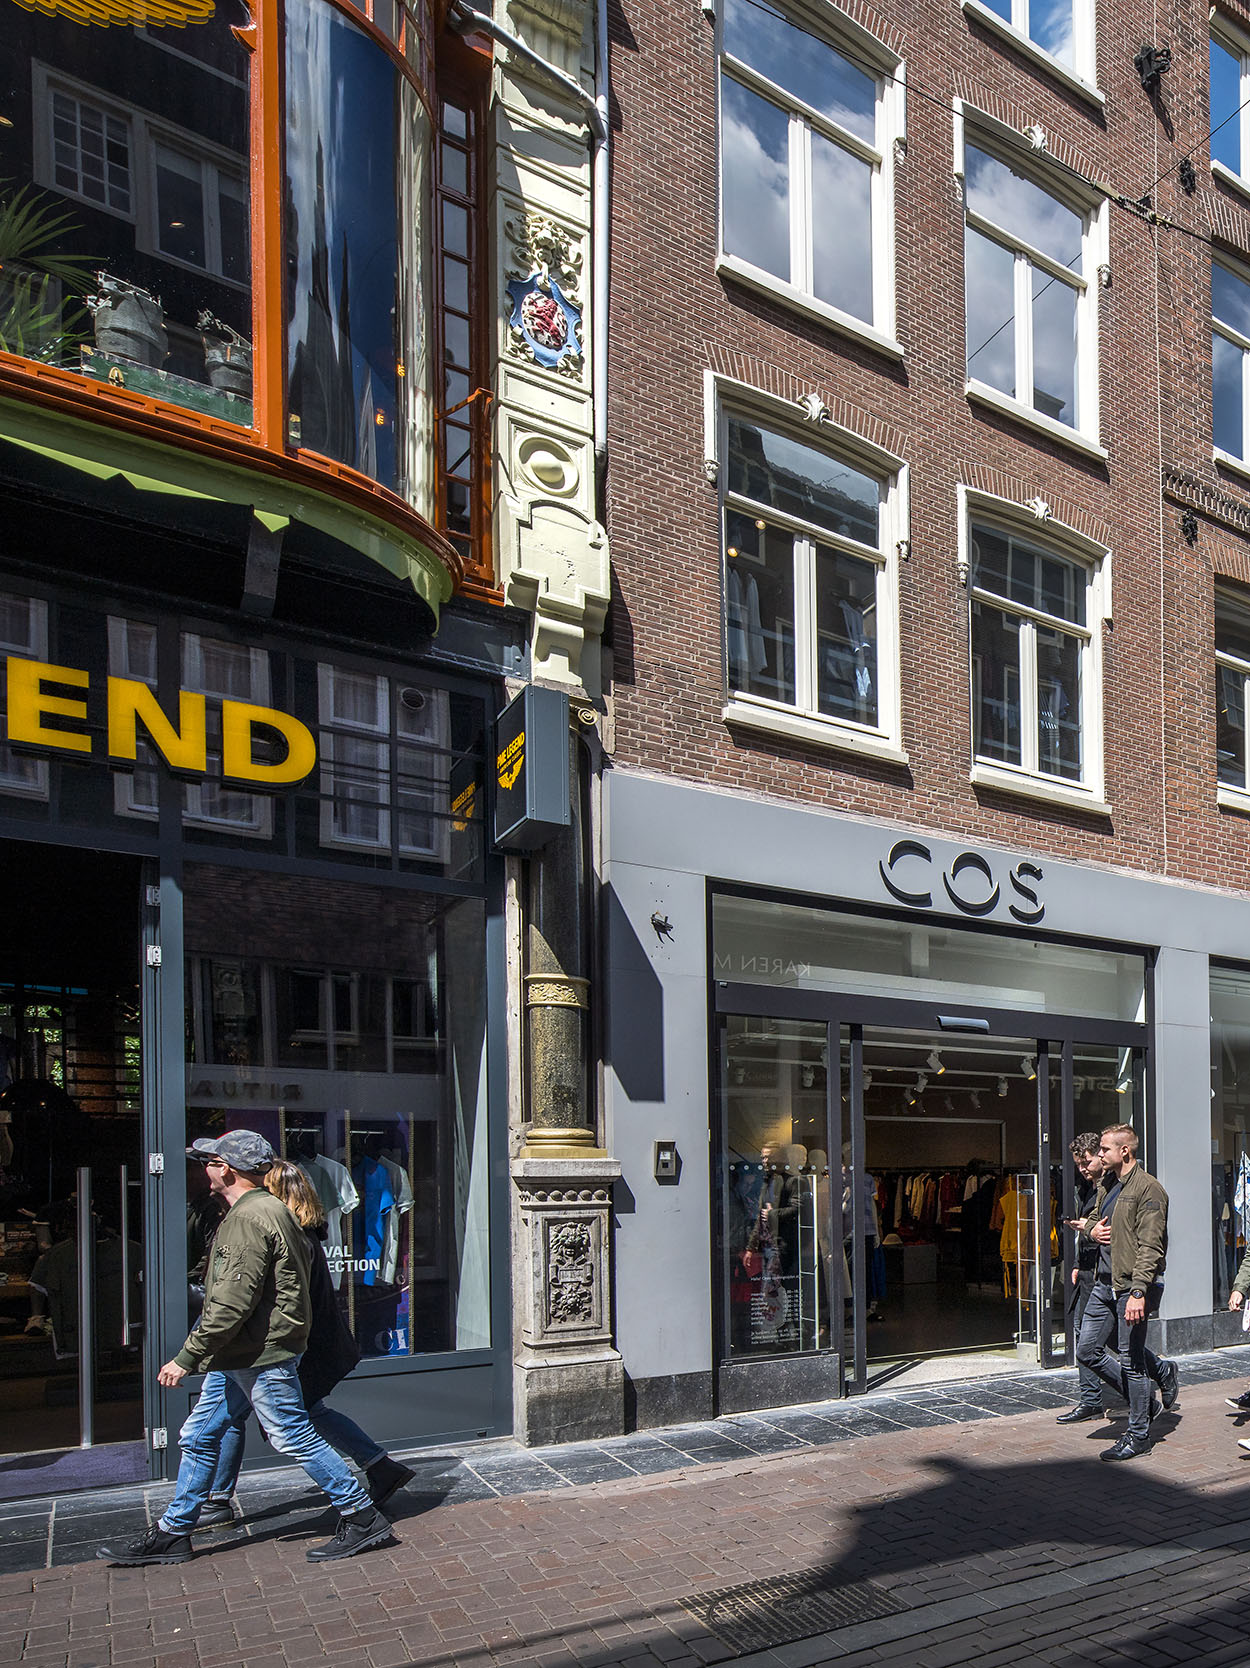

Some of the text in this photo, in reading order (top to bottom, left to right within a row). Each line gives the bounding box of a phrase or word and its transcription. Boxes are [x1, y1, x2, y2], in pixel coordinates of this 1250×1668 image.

[6, 655, 317, 784] END
[878, 839, 1046, 926] COS
[322, 1245, 353, 1259] VAL
[326, 1258, 381, 1273] ECTION
